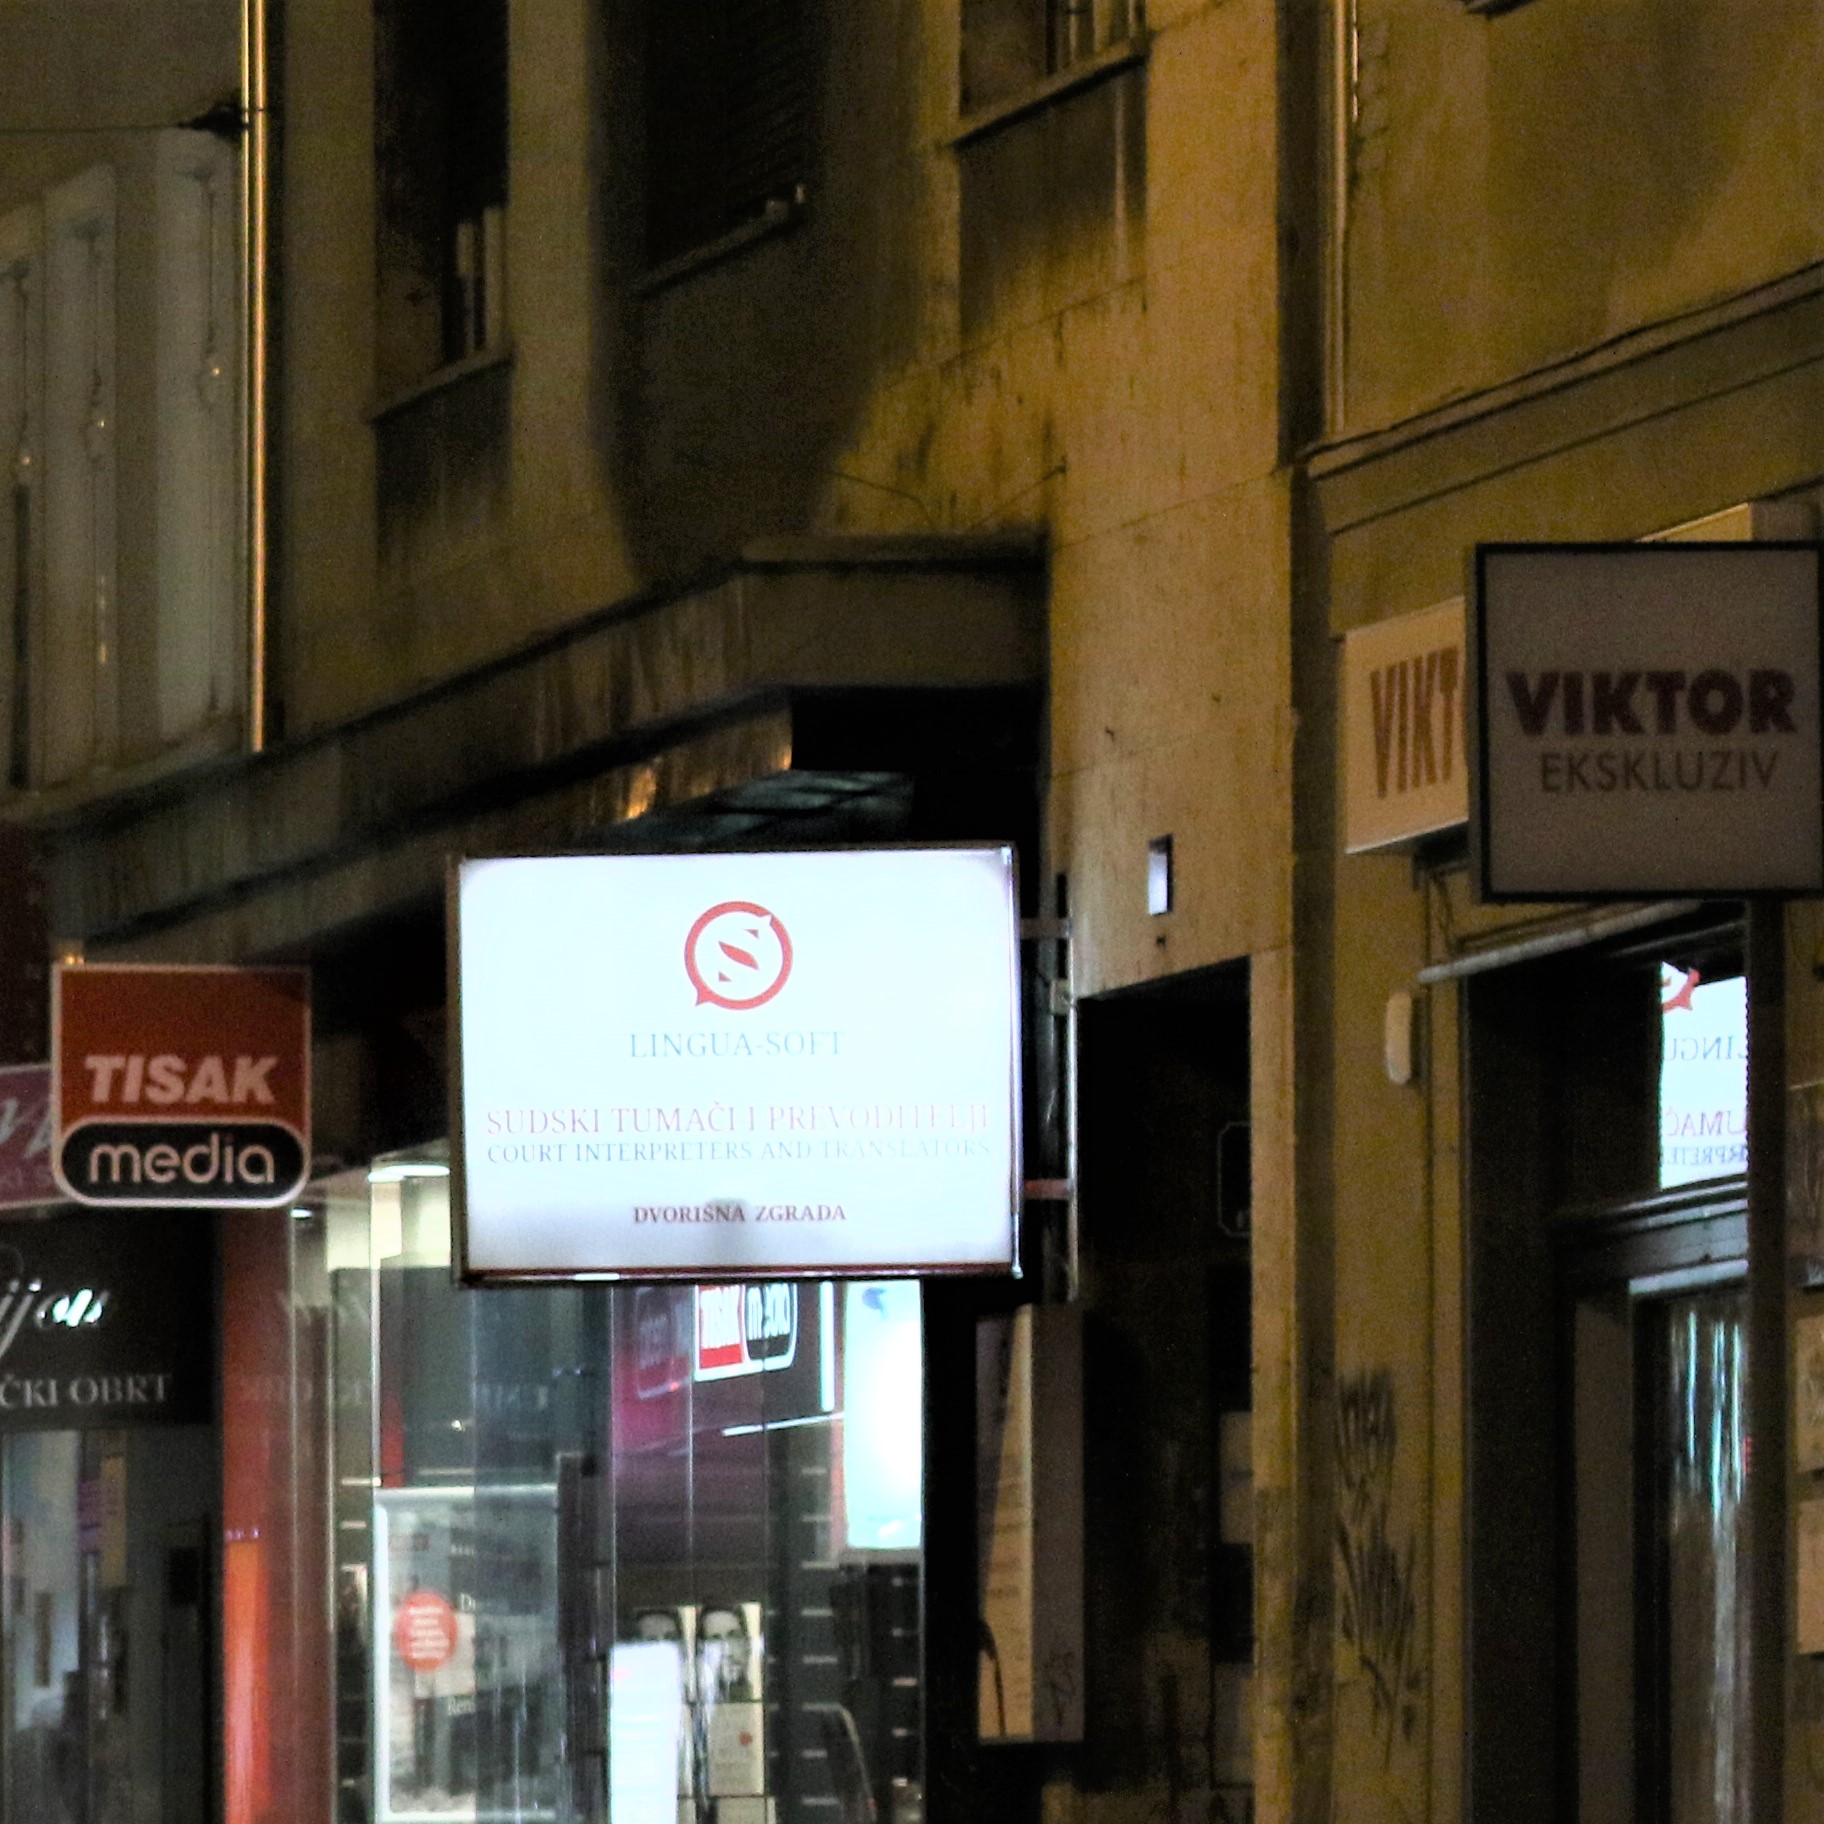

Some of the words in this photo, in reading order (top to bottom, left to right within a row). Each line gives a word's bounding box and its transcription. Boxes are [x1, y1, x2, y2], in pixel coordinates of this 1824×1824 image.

[1506, 668, 1798, 738] VIKTOR
[1539, 750, 1779, 793] EKSKLUZIV
[630, 1029, 843, 1058] LINGUA-SOFT
[85, 1054, 278, 1104] TISAK
[487, 1108, 600, 1135] SUDSKI
[611, 1101, 736, 1134] TUMAČI
[89, 1131, 275, 1184] media
[487, 1143, 567, 1164] COURT
[575, 1142, 752, 1163] INTERPRETERS
[761, 1141, 812, 1161] AND
[822, 1139, 991, 1161] TRANSLATORS
[634, 1202, 746, 1224] DVORIŠNA
[755, 1202, 847, 1223] ZGRADA
[70, 1374, 173, 1405] OBRT
